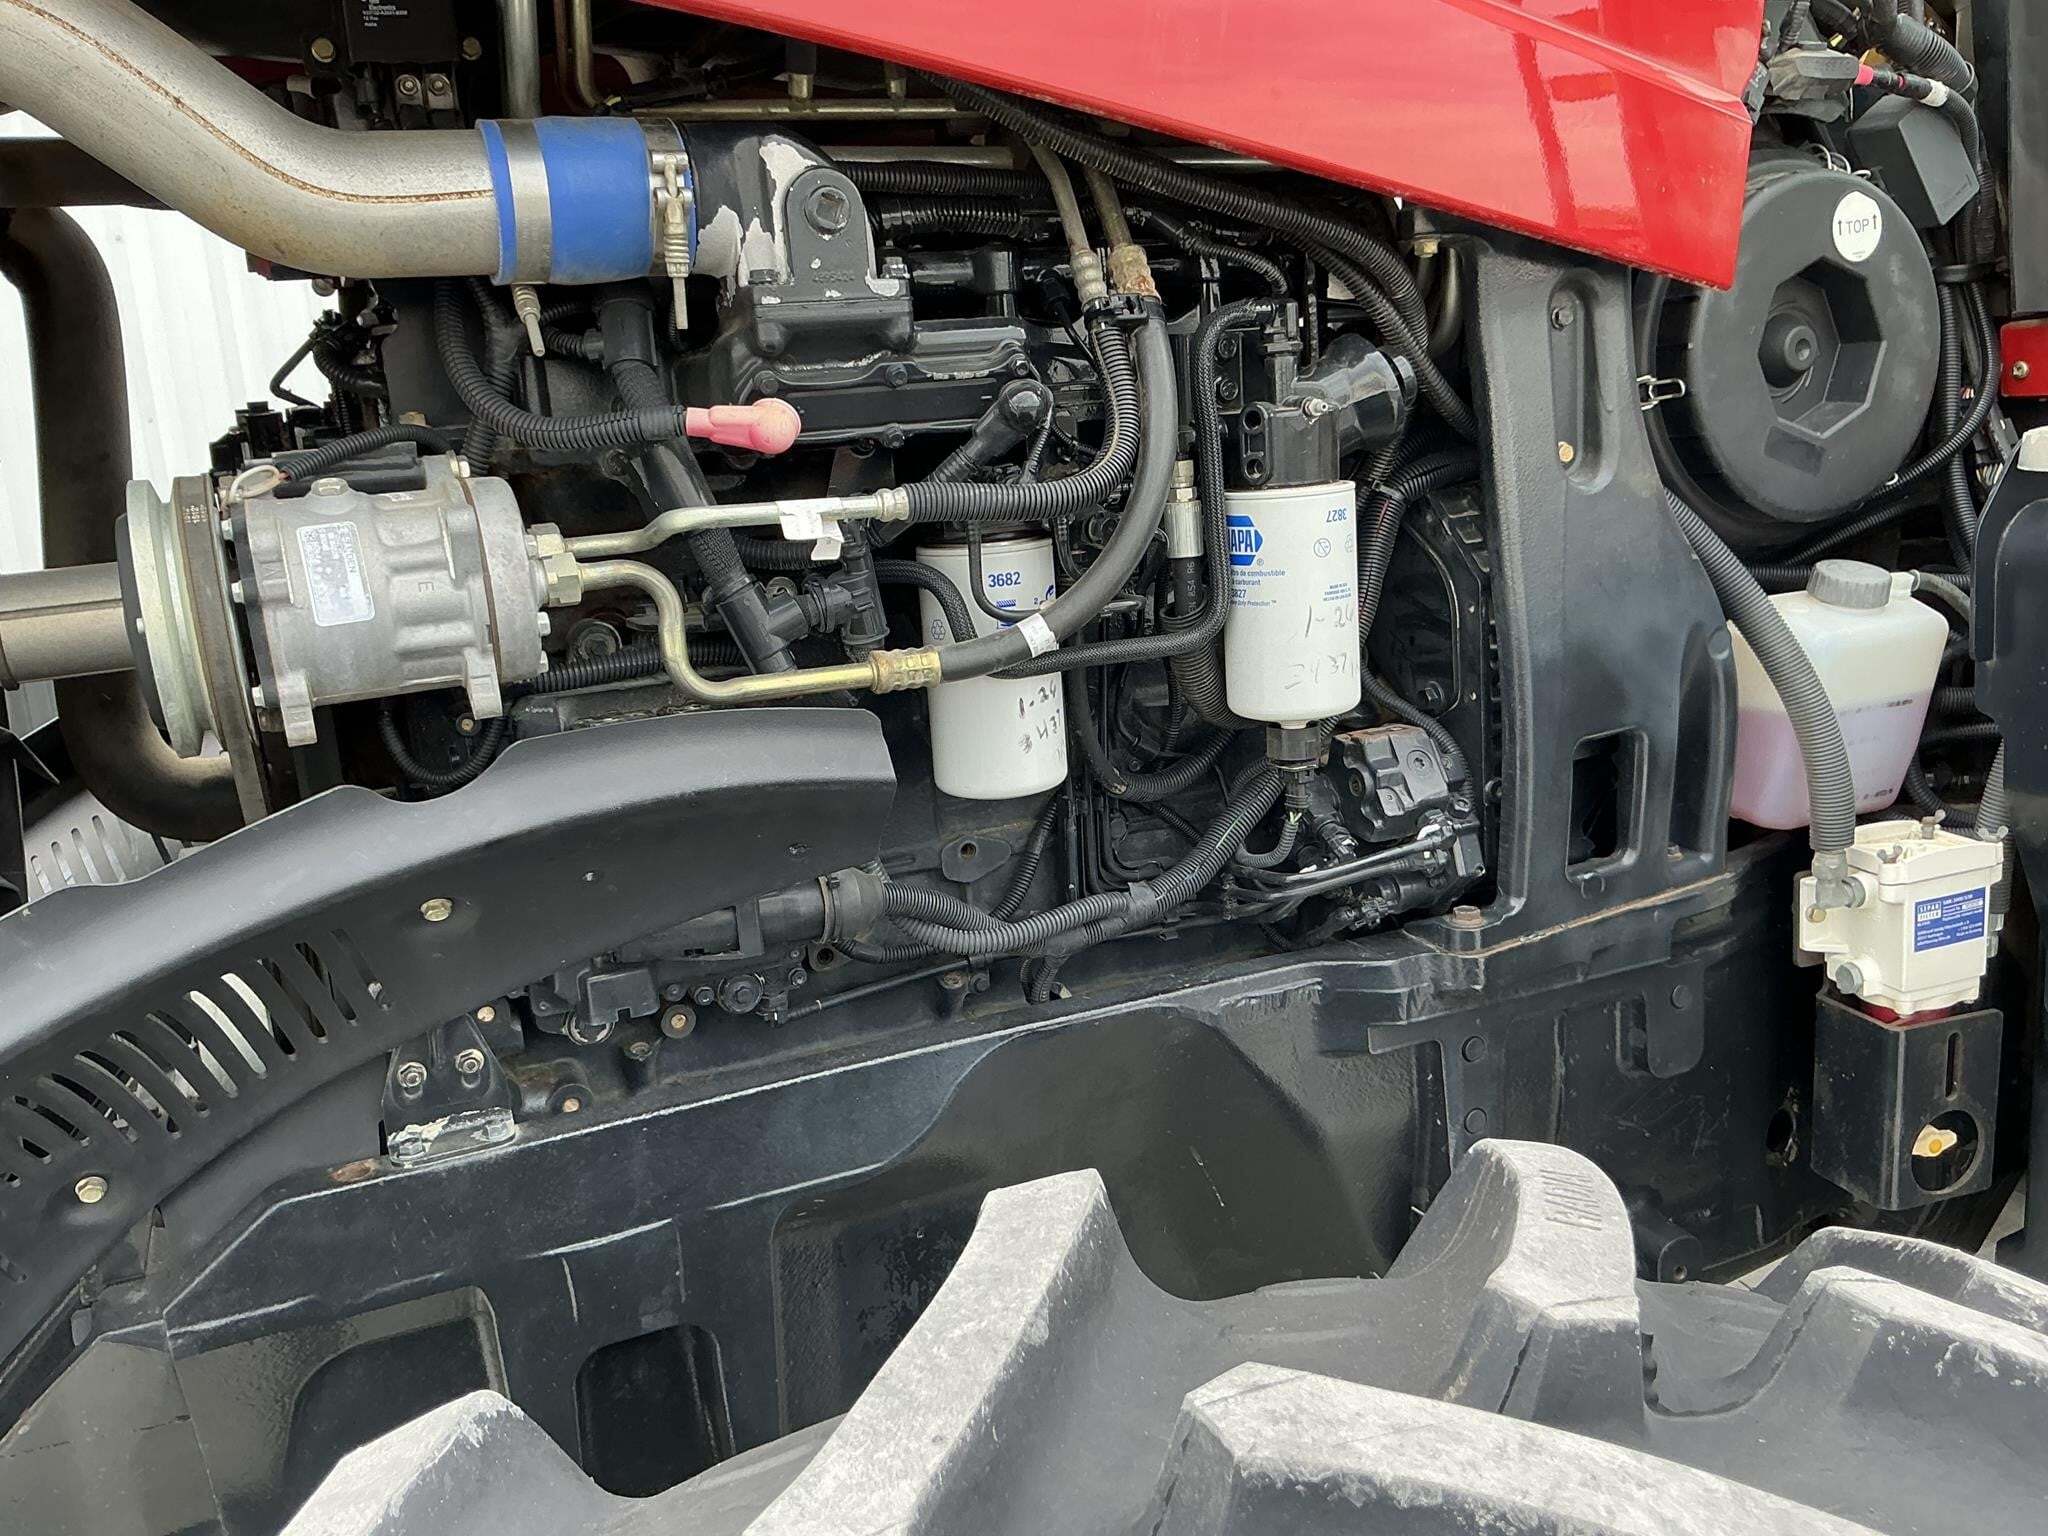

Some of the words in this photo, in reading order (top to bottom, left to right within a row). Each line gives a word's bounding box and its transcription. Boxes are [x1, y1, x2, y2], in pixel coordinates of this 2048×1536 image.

[1845, 218, 1870, 235] TOP
[1326, 507, 1348, 523] 3827
[988, 571, 1021, 588] 3682
[1247, 569, 1286, 577] combustible
